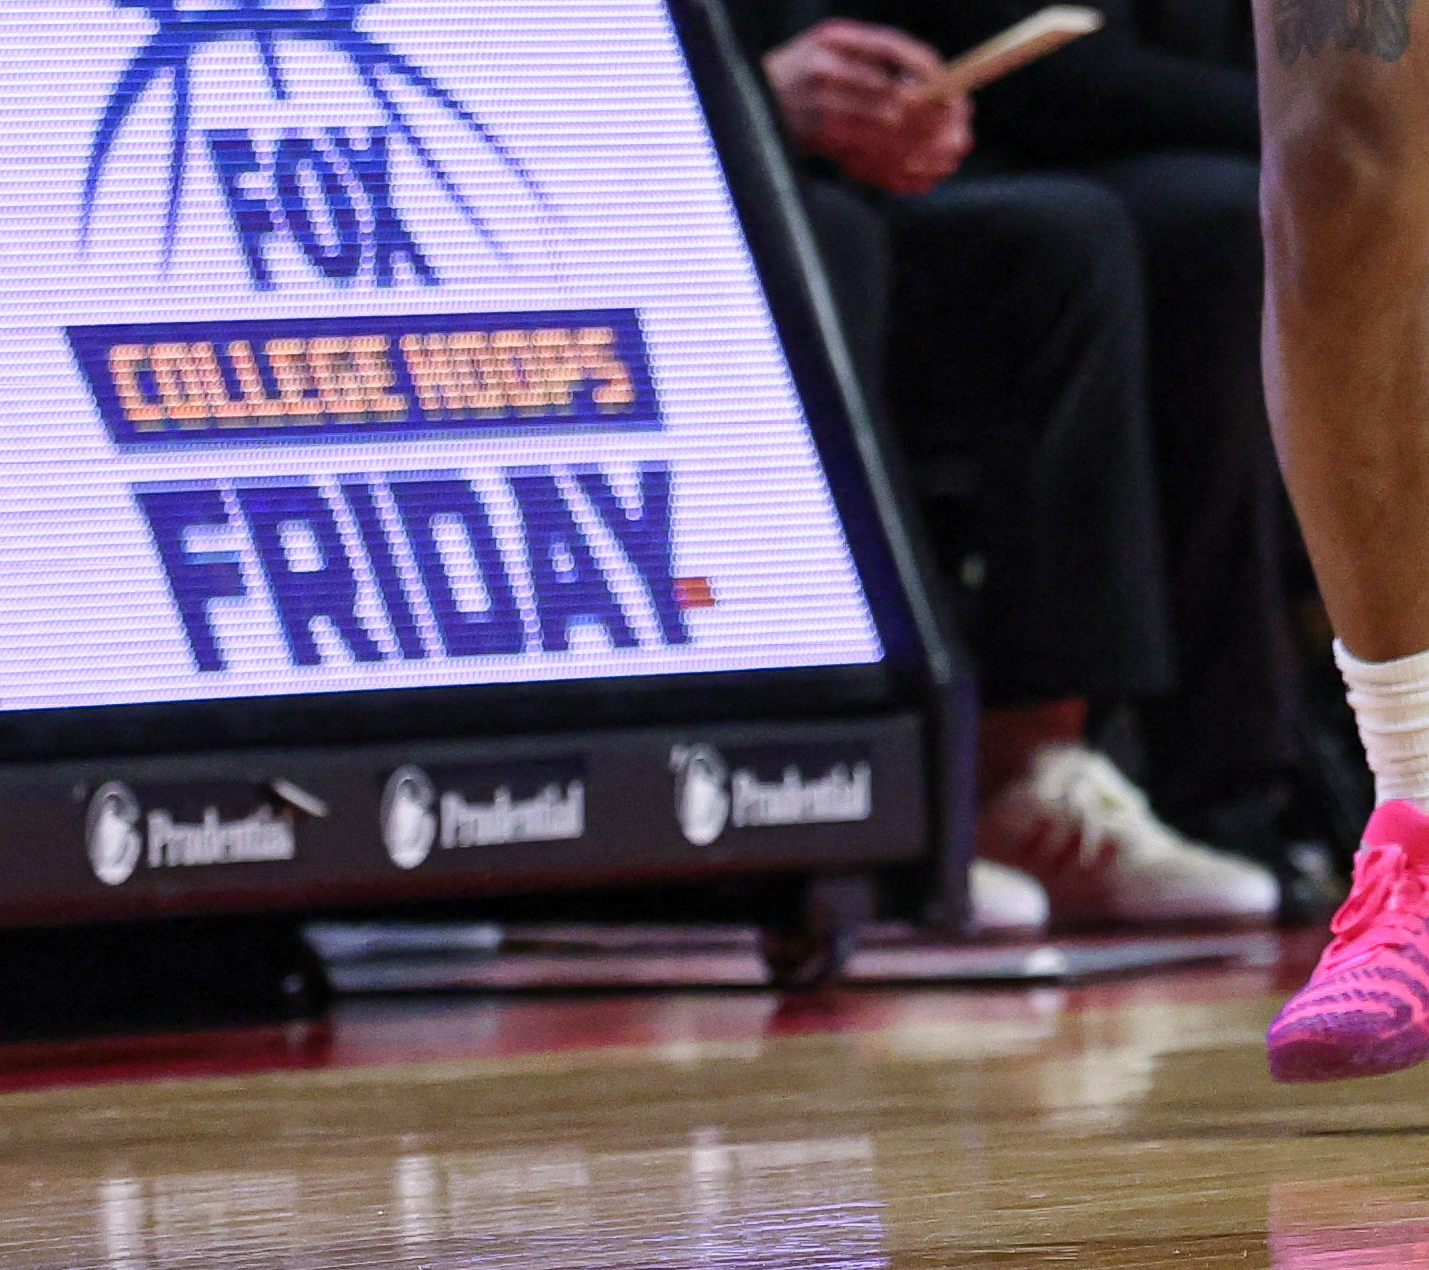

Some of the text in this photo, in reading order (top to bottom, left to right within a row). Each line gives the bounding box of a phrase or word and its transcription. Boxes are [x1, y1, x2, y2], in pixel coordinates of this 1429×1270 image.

[204, 128, 440, 291] FOX
[110, 327, 635, 430] COLLEGE HOOPS
[732, 760, 872, 828] Prudential
